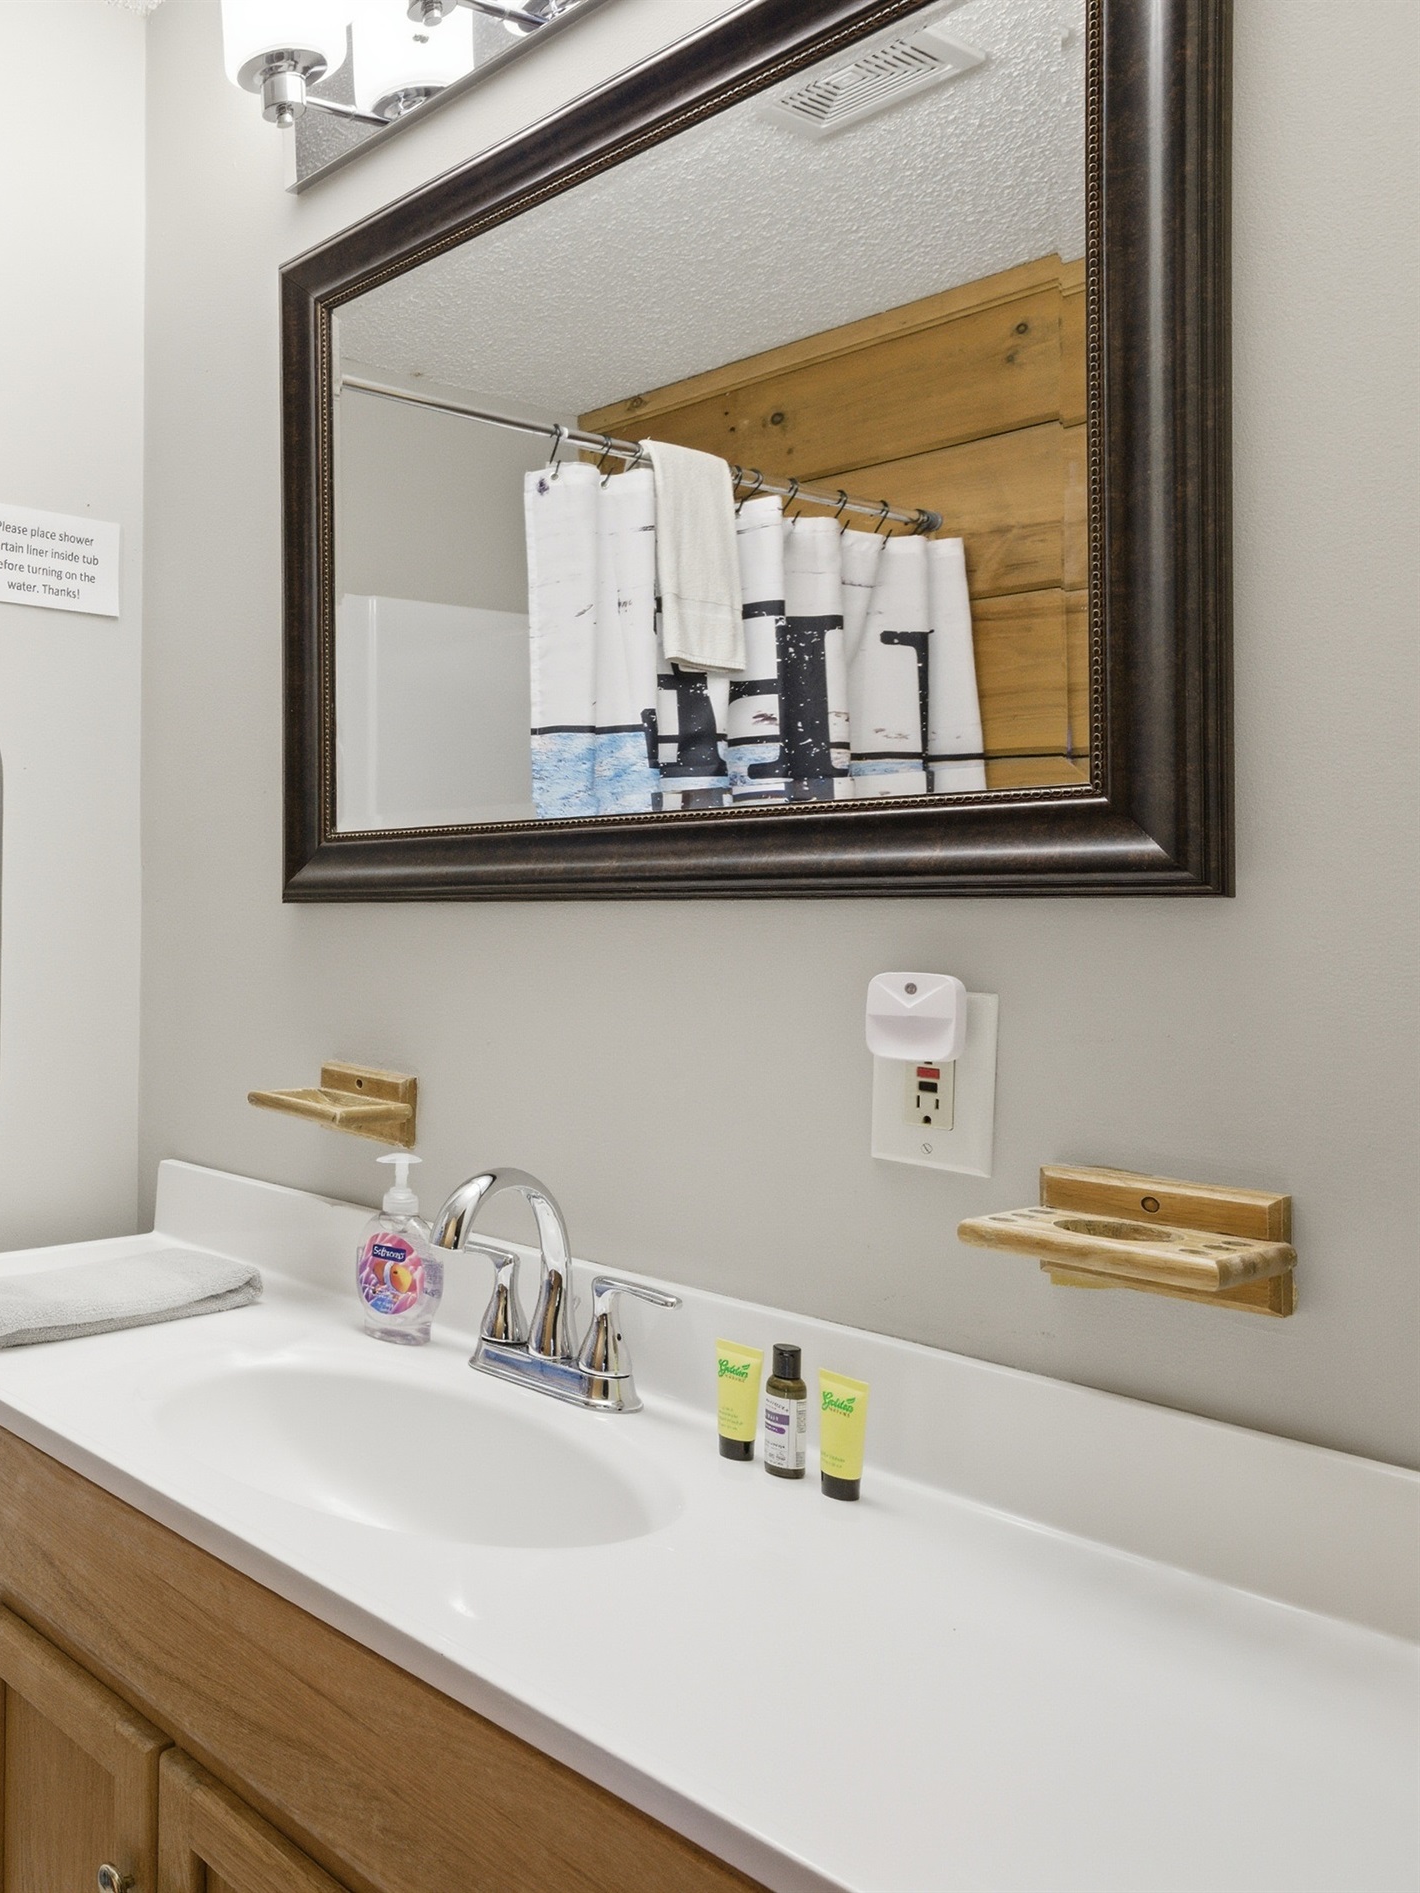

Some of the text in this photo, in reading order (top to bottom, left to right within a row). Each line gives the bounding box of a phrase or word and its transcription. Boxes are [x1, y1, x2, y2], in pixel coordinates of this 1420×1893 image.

[30, 526, 57, 541] place
[58, 531, 95, 547] shower
[26, 543, 49, 558] liner
[51, 548, 80, 563] inside
[82, 554, 99, 566] tub
[27, 563, 63, 581] turning
[65, 571, 78, 581] on
[79, 572, 96, 584] the
[7, 579, 81, 600] water. Thanks!
